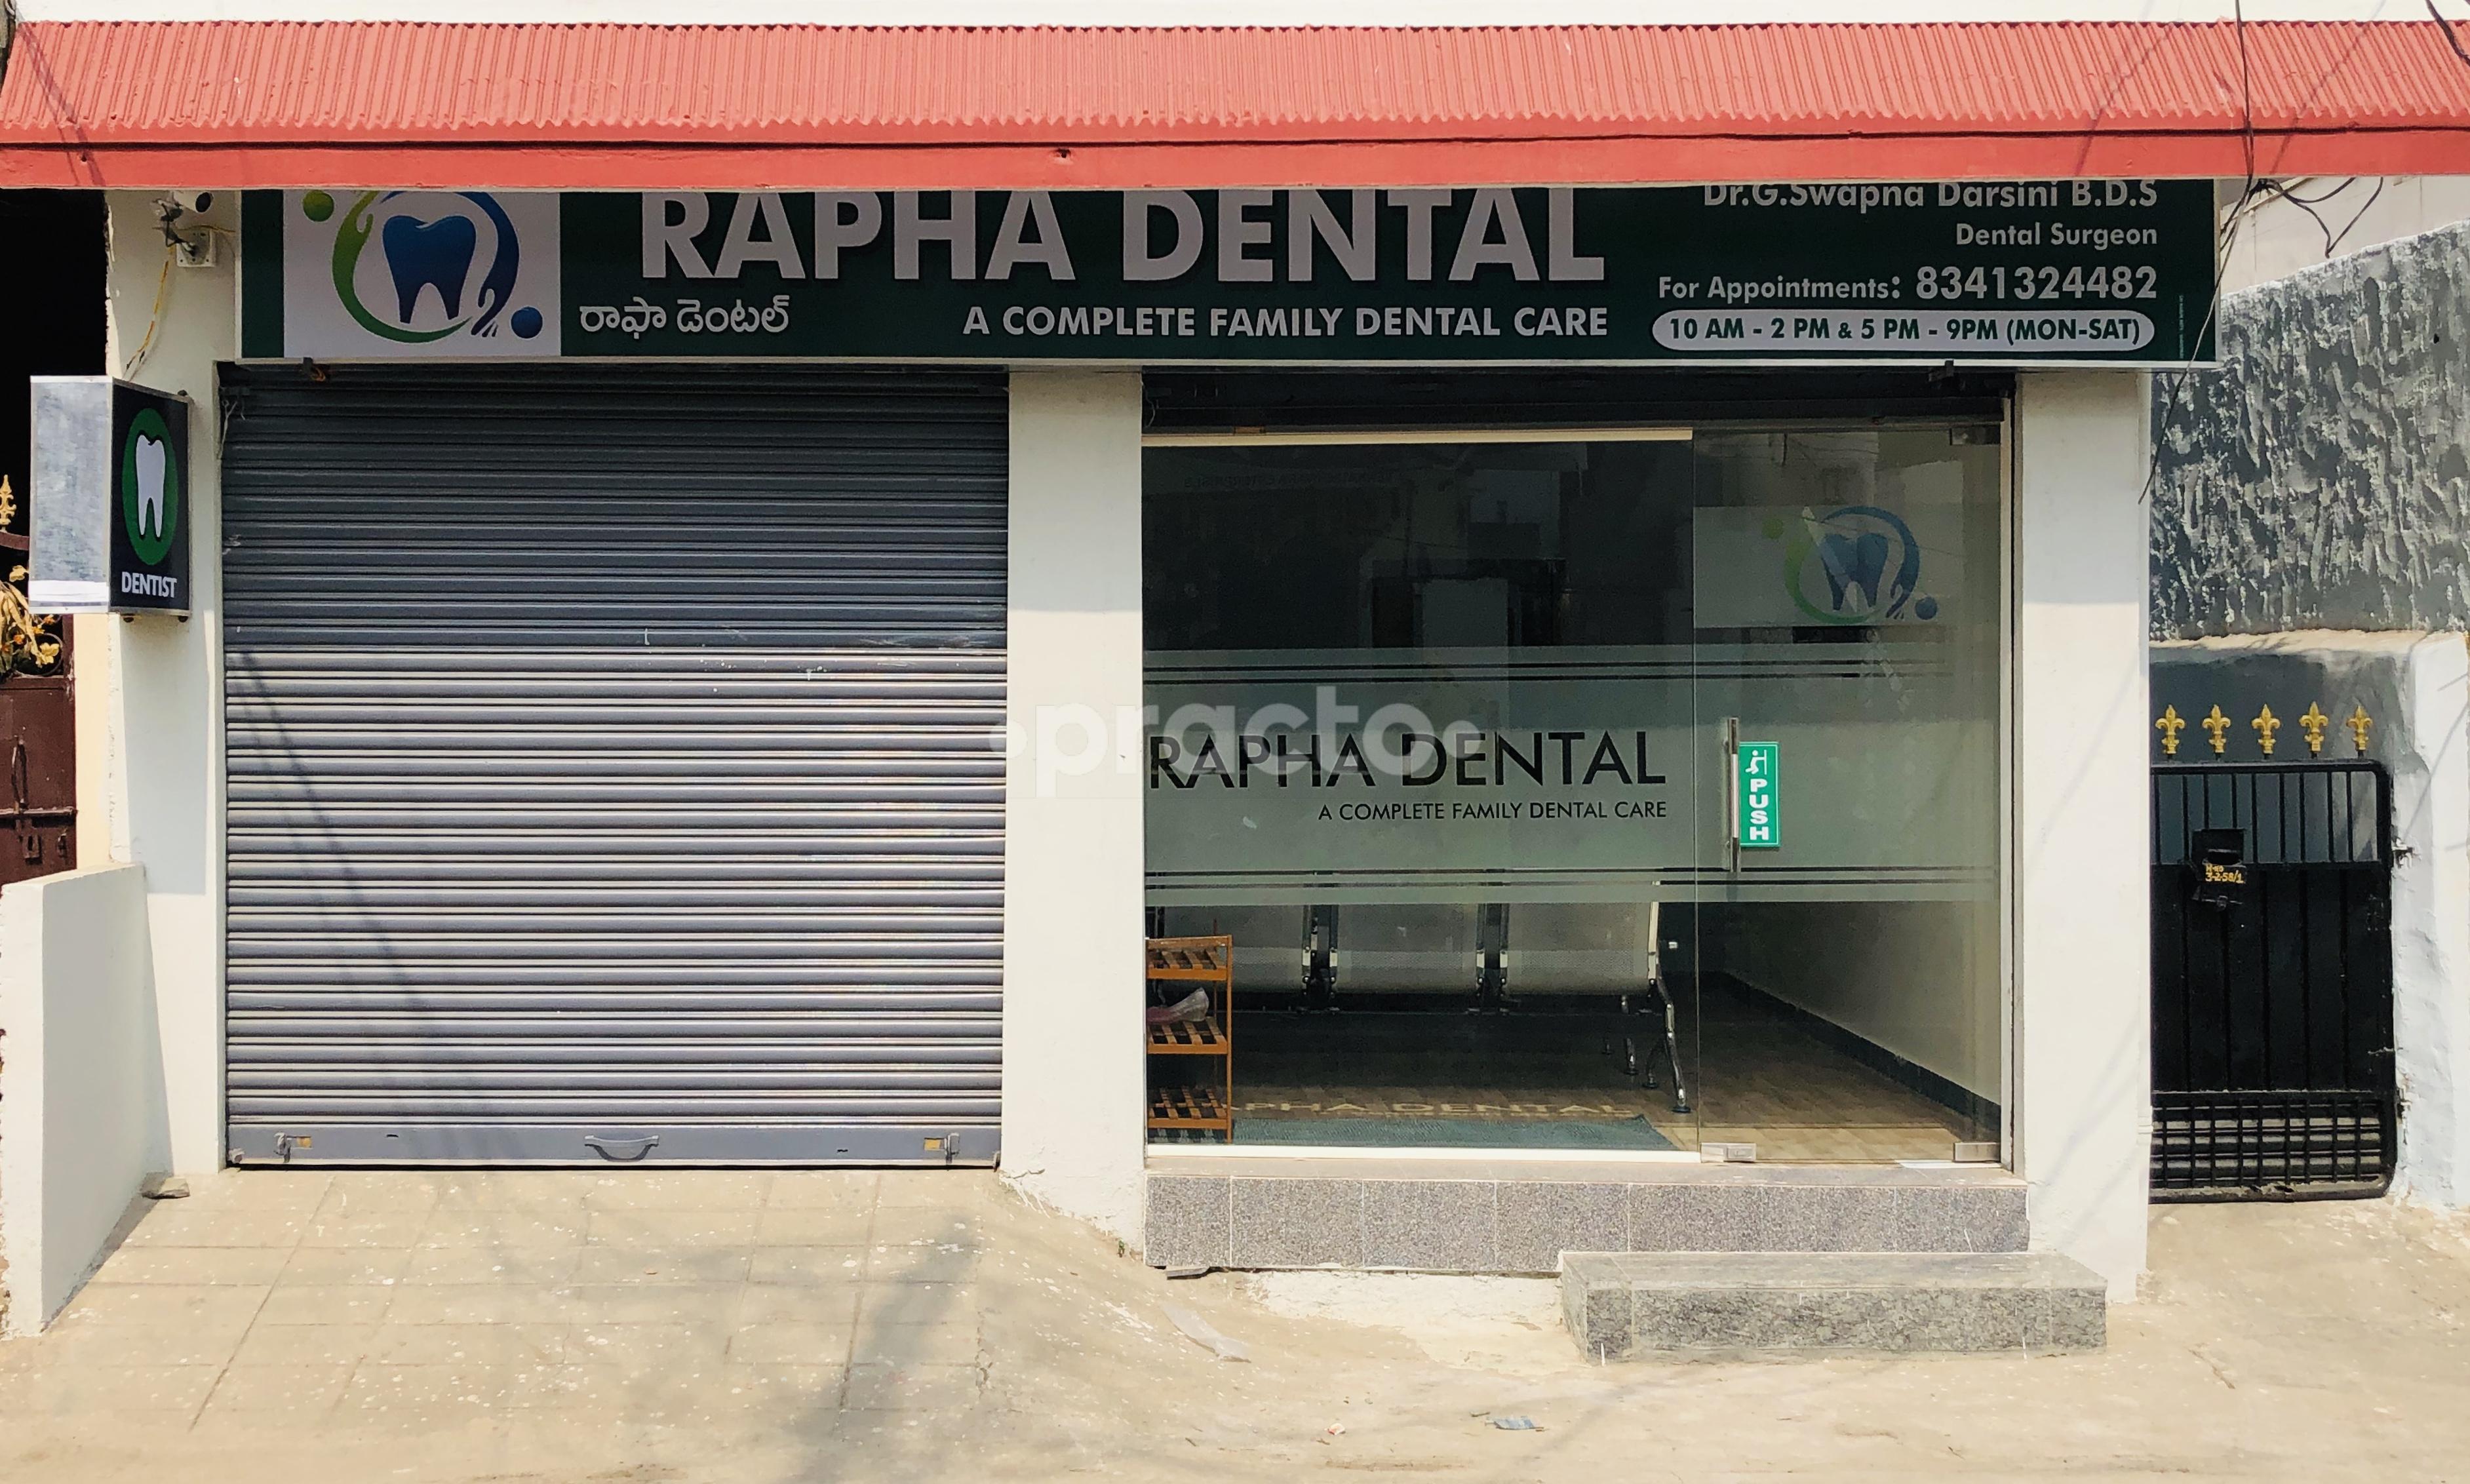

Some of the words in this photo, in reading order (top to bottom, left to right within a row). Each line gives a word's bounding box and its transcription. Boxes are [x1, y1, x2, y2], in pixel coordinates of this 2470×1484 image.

[1704, 184, 1924, 214] Dr.G.Swapna
[1938, 181, 2058, 206] Darsini
[2072, 180, 2158, 207] B.D.S
[641, 190, 1076, 281] RAPHA
[1122, 189, 1605, 282] DENTAL
[1956, 222, 2041, 245] Dental
[2050, 222, 2158, 250] Surgeon
[1658, 276, 1699, 299] For
[1707, 275, 1900, 303] Appointments:
[1916, 265, 2157, 300] 8341324482
[579, 296, 667, 340] రాఫా
[676, 295, 791, 334] డెంటల్
[962, 306, 990, 335] A
[1002, 306, 1196, 336] COMPLETE
[1210, 307, 1344, 337] FAMILY
[1355, 307, 1501, 337] DENTAL
[1512, 307, 1609, 336] CARE
[1670, 317, 1698, 340] 10
[1705, 317, 1744, 339] AM
[1771, 318, 1785, 339] 2
[1794, 317, 1830, 339] PM
[1838, 321, 1852, 339] &
[1861, 318, 1875, 340] 5
[1883, 318, 1920, 340] PM
[1946, 318, 1998, 340] 9PM
[2007, 318, 2140, 345] (MON-SAT)
[121, 571, 178, 598] DENTIST
[1150, 732, 1376, 789] RAPHA
[1402, 730, 1666, 787] DENTAL
[1318, 804, 1332, 821] A
[1339, 802, 1445, 821] COMPLETE
[1452, 801, 1522, 819] FAMILY
[1530, 800, 1608, 819] DENTAL
[1615, 800, 1667, 819] CARE
[1749, 778, 1769, 840] PUSH
